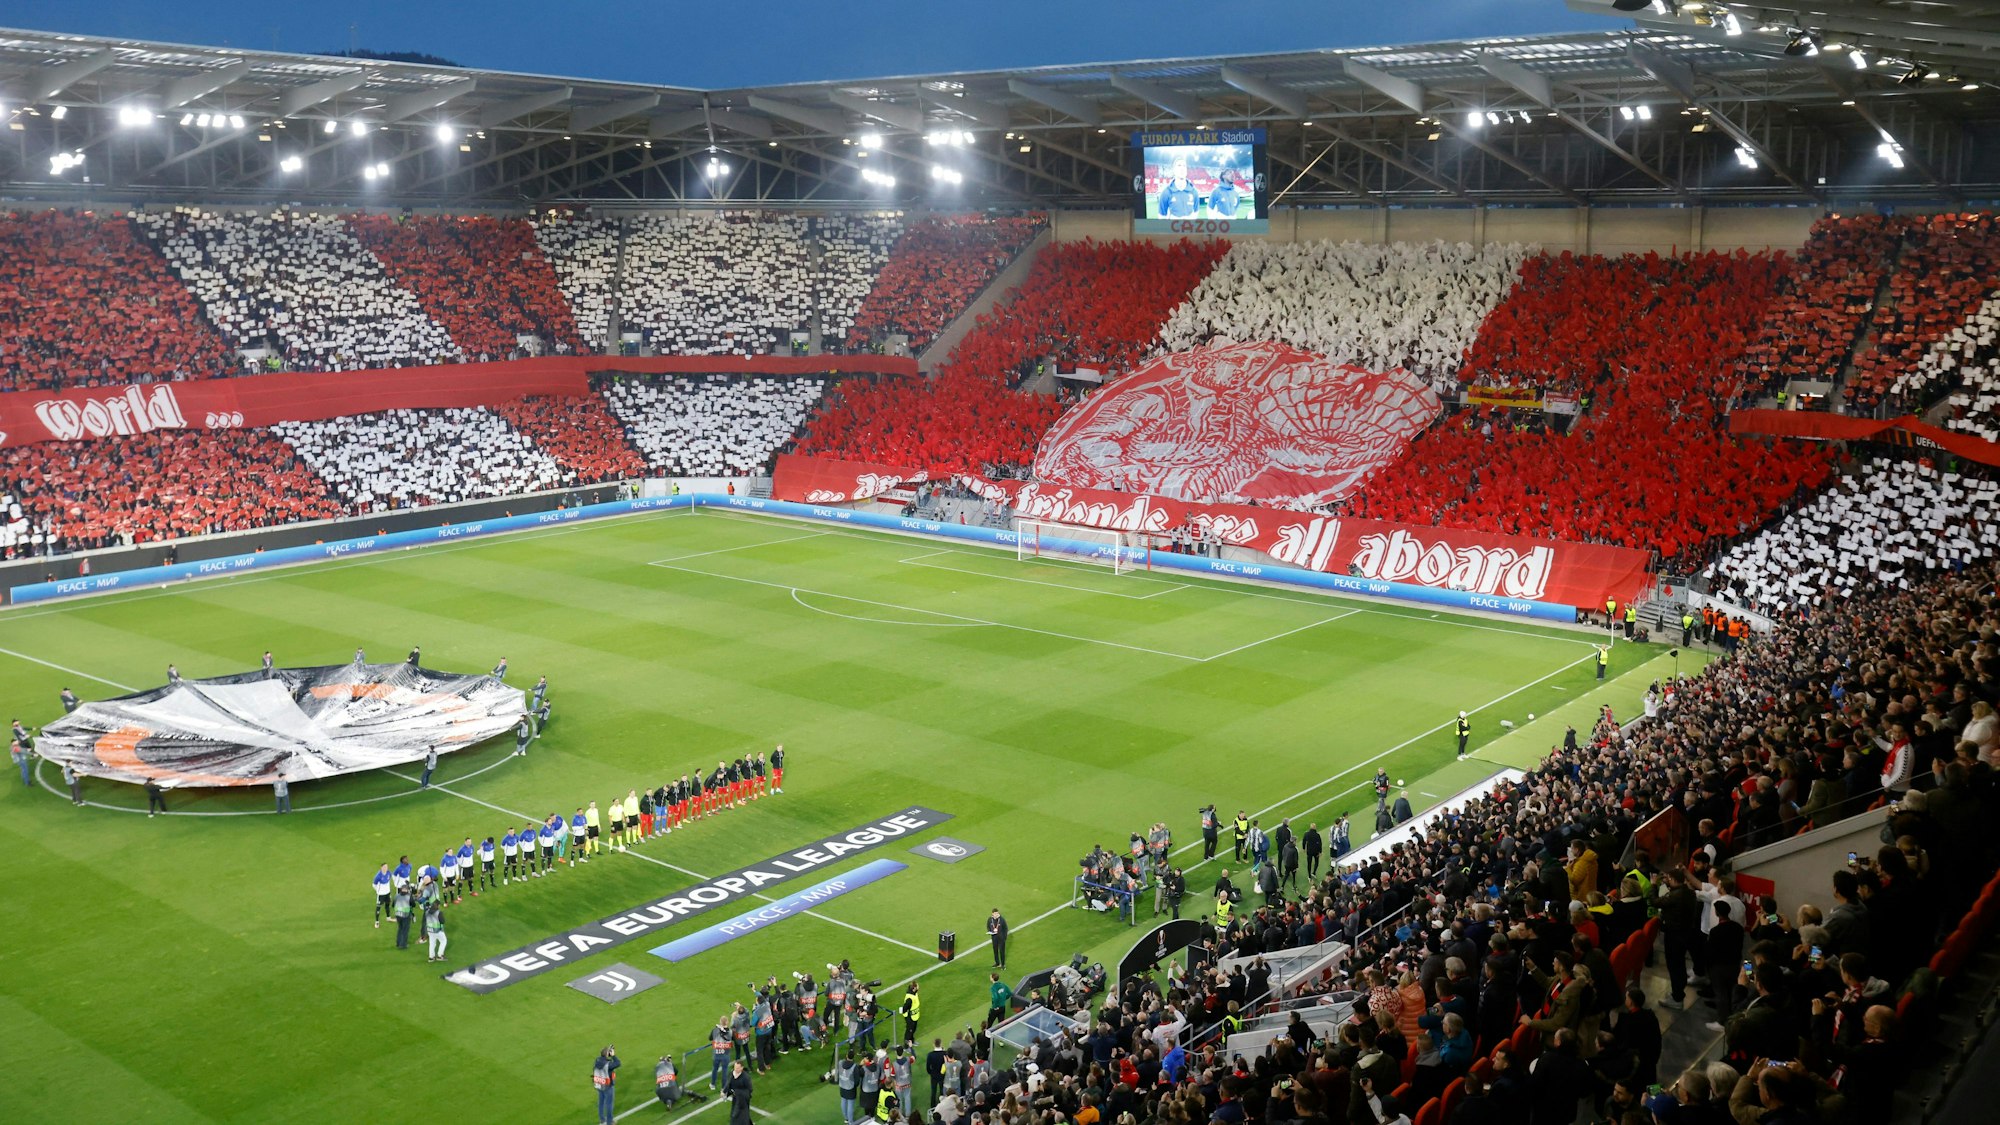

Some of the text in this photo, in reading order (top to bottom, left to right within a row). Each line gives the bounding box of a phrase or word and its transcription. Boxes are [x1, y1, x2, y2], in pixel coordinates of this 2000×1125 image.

[1141, 131, 1255, 145] EUROPA PARK Stadion
[1171, 219, 1231, 234] CAZOO
[33, 384, 188, 441] world
[631, 501, 650, 509] PEACE
[729, 498, 747, 506] PEACE
[539, 513, 559, 522] PEACE
[565, 510, 579, 519] МИР
[813, 508, 832, 517] PEACE
[837, 511, 851, 519] МИР
[438, 526, 460, 537] PEACE
[466, 524, 483, 534] МИР
[901, 520, 921, 529] PEACE
[926, 523, 941, 532] МИР
[996, 532, 1016, 542] PEACE
[326, 543, 350, 554] PEACE
[357, 539, 375, 549] МИР
[1128, 551, 1145, 560] МИР
[1267, 517, 1341, 572] all
[1351, 529, 1554, 599] aboard
[200, 560, 228, 573] PEACE
[235, 557, 255, 568] МИР
[1211, 562, 1235, 572] PEACE
[1242, 566, 1262, 575] МИР
[57, 581, 87, 594] PEACE
[96, 576, 120, 588] МИР
[1334, 578, 1361, 590] PEACE
[1369, 583, 1390, 593] МИР
[1470, 596, 1499, 609] PEACE
[1508, 602, 1532, 612] МИР
[719, 905, 791, 935] PEACE
[800, 880, 847, 903] МИР
[459, 933, 613, 985] UEFA
[601, 870, 786, 935] EUROPA
